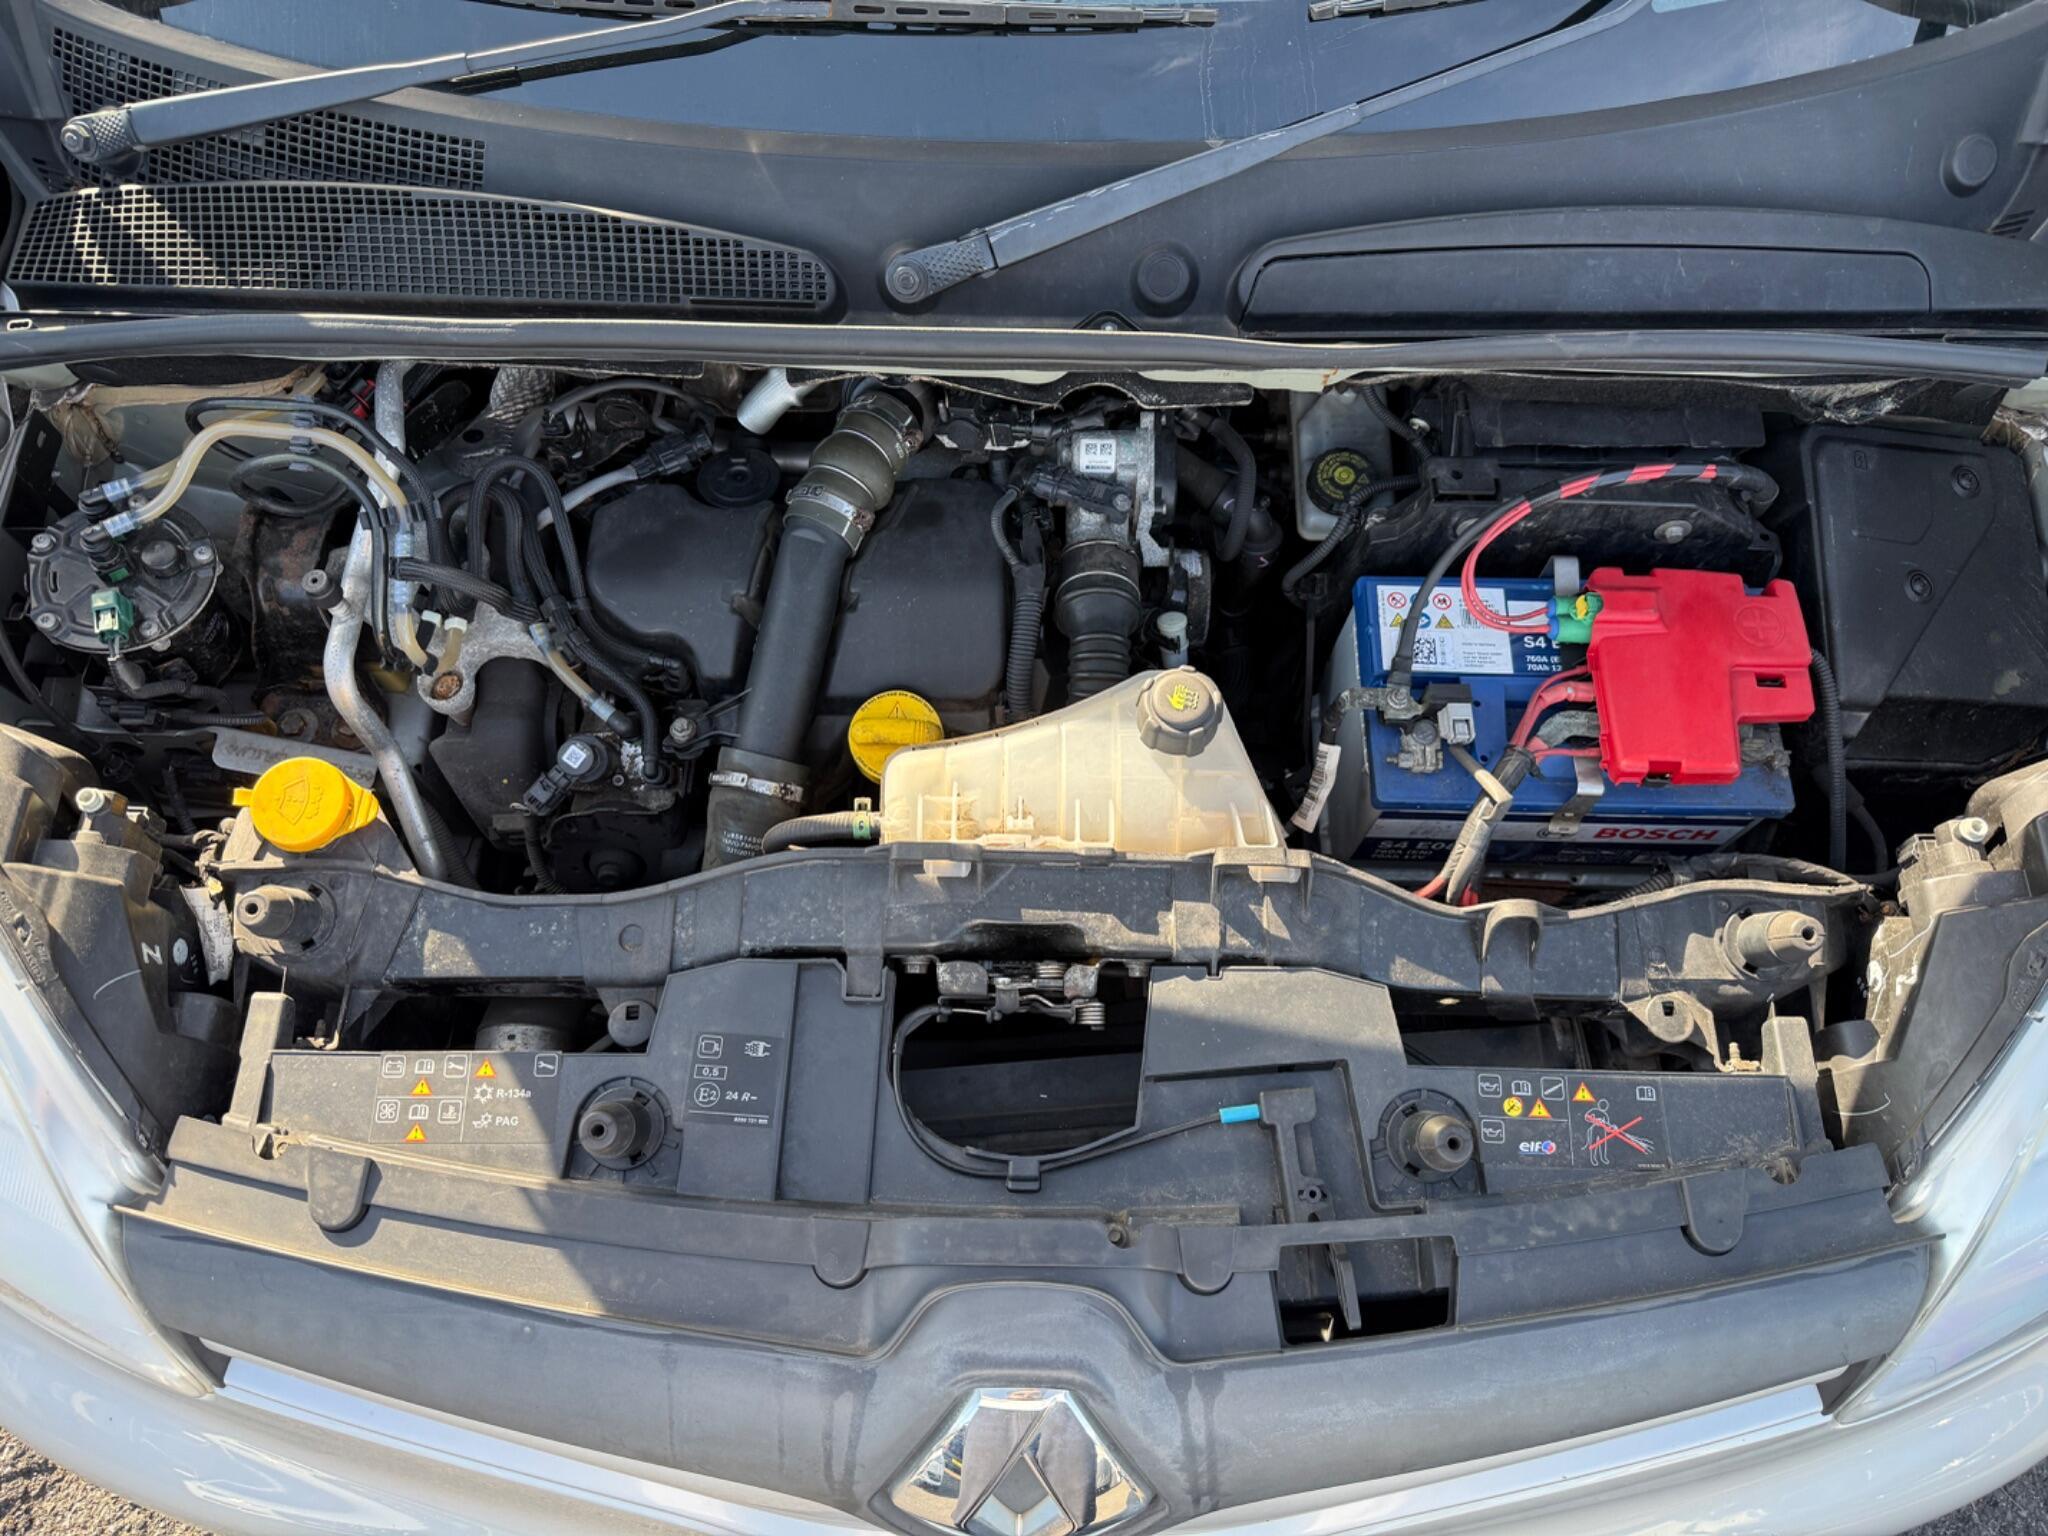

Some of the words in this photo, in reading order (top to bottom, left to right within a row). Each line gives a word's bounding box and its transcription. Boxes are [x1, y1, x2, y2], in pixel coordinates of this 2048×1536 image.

[1523, 635, 1547, 649] S4
[1550, 655, 1561, 664] (E
[1551, 664, 1562, 672] 12
[1593, 828, 1719, 841] BOSCH
[1378, 840, 1409, 849] S4
[702, 1067, 720, 1077] 0,5
[496, 1088, 532, 1098] R-134a
[699, 1087, 717, 1102] E2
[725, 1091, 739, 1100] 24
[495, 1115, 519, 1126] PAG
[1519, 1140, 1543, 1152] elf
